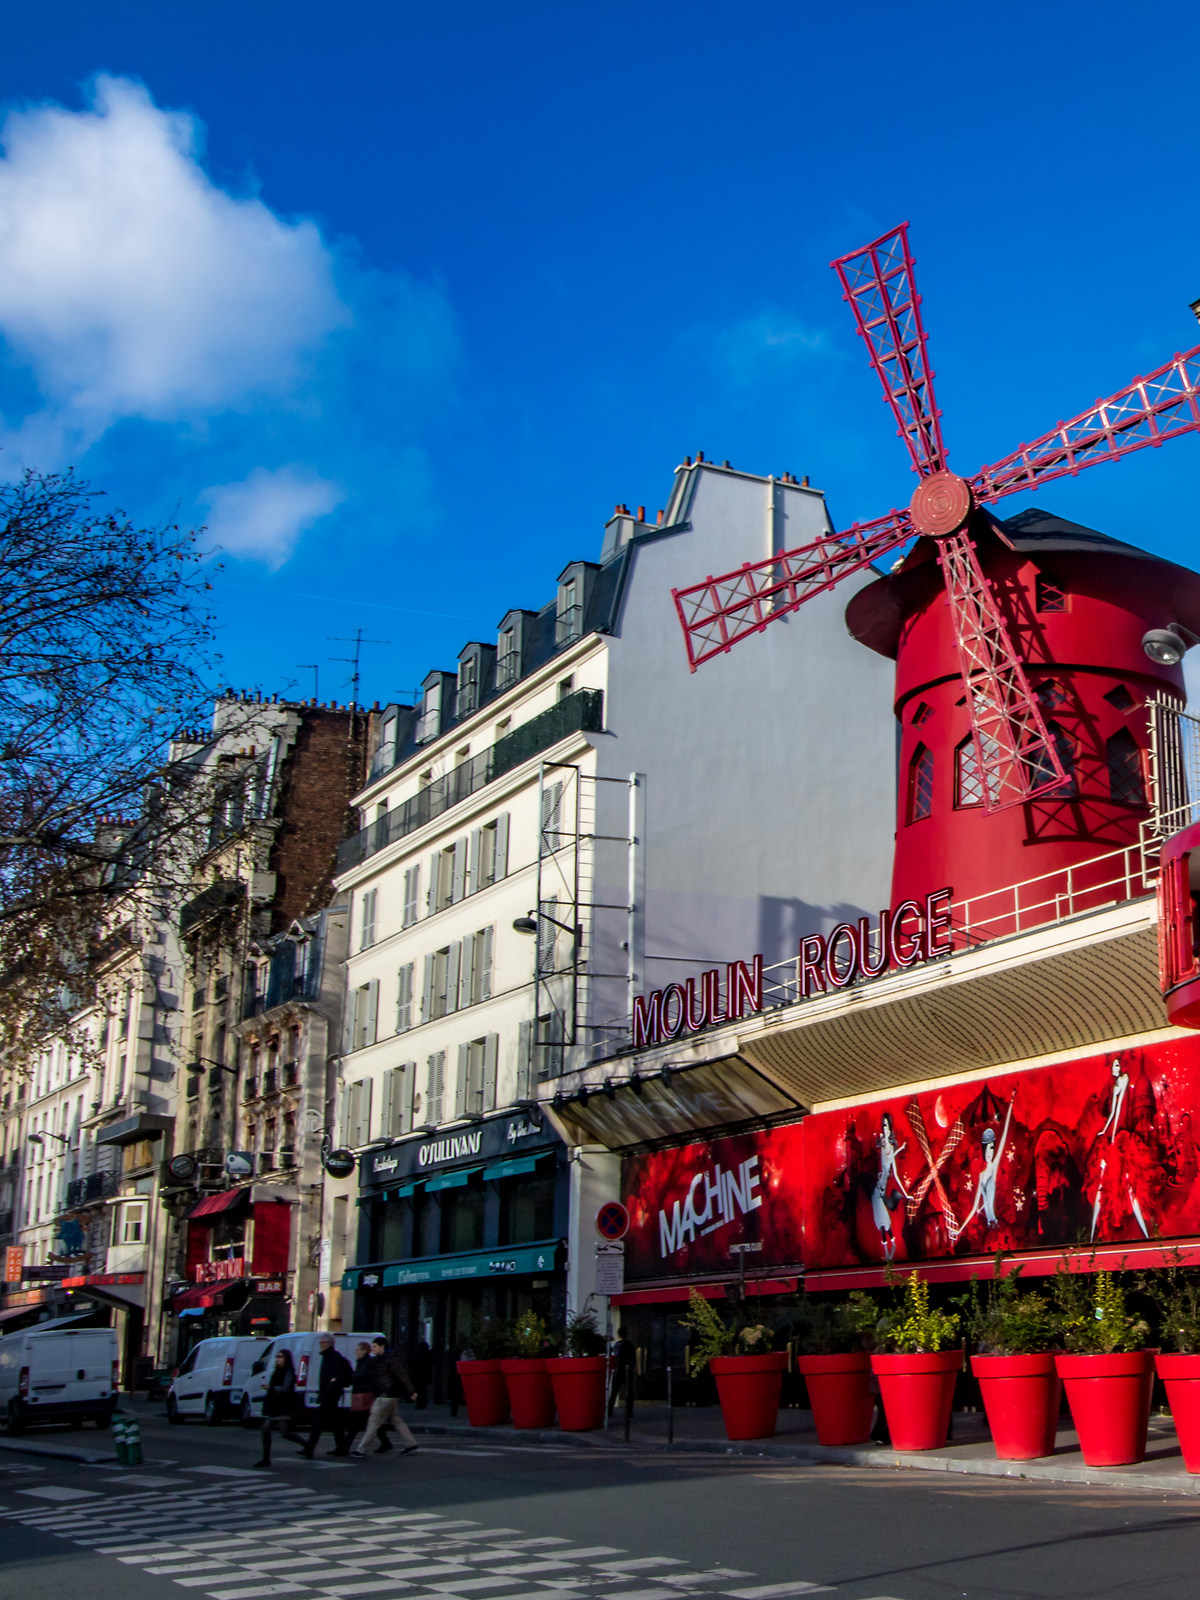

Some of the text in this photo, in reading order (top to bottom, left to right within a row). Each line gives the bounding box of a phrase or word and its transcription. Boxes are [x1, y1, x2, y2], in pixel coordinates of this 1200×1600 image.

[631, 886, 954, 1048] MOULIN ROUGE
[419, 1132, 482, 1166] O'SULLIVANS
[659, 1155, 762, 1258] MACHINE
[258, 1282, 281, 1292] BAR
